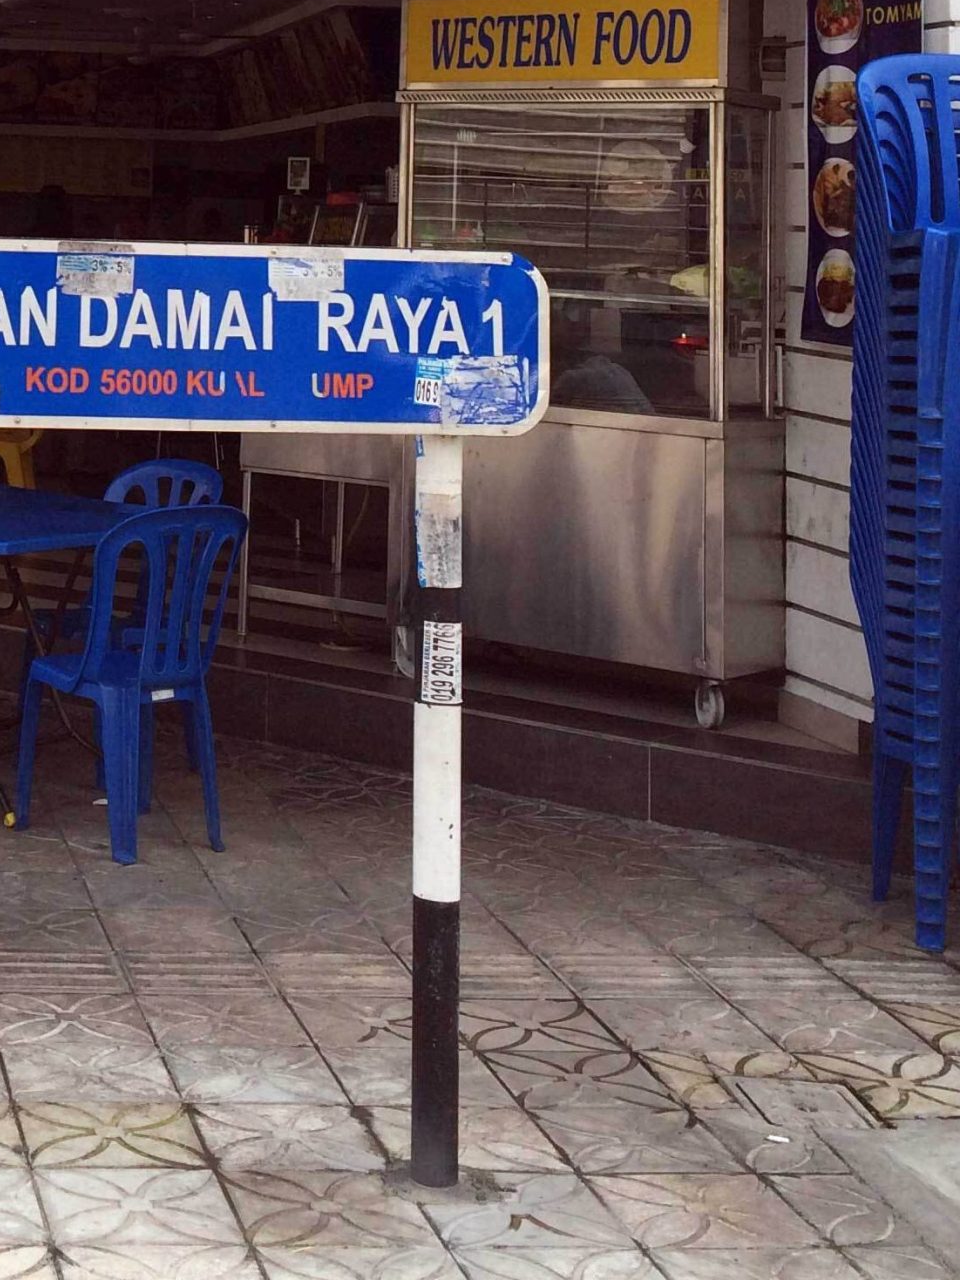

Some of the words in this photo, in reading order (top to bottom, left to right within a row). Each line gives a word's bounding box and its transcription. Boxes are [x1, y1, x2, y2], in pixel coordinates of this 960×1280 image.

[866, 1, 923, 25] TOMYAM
[431, 11, 580, 71] WESTERN
[592, 8, 693, 66] FOOD
[79, 288, 274, 351] DAMAI
[318, 292, 470, 355] RAYA
[482, 299, 504, 357] 1
[25, 366, 89, 394] KOD
[100, 369, 178, 395] 56000
[431, 655, 454, 677] 296
[430, 680, 453, 702] 019
